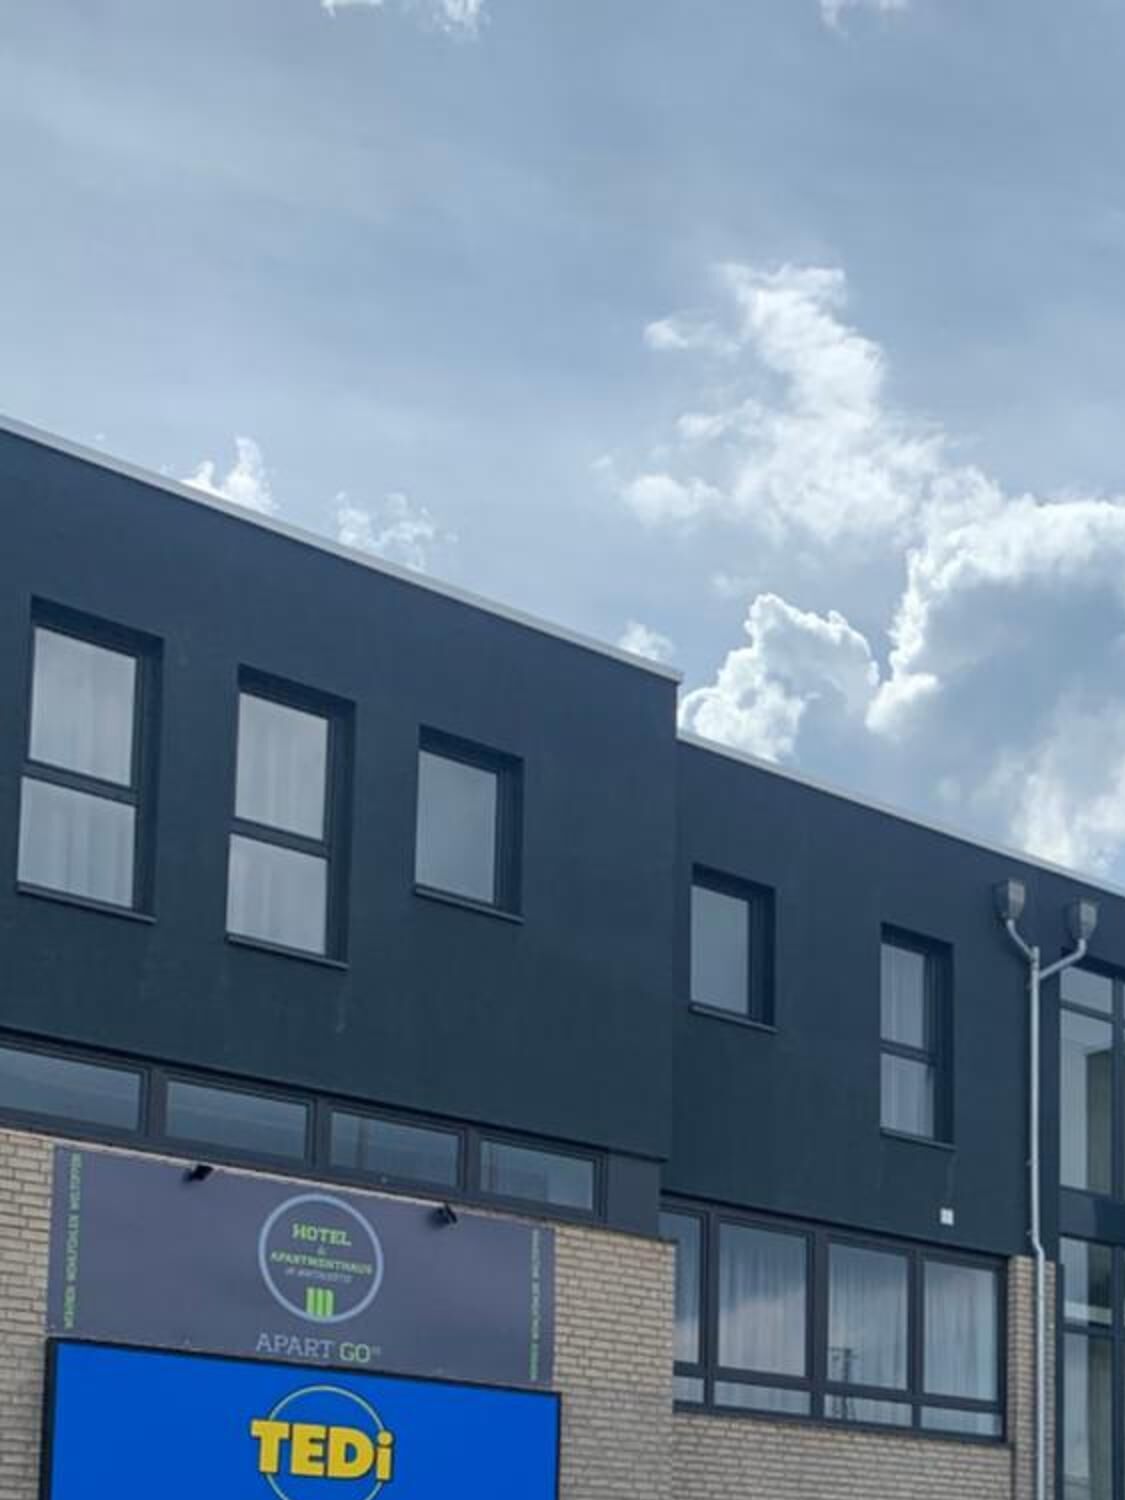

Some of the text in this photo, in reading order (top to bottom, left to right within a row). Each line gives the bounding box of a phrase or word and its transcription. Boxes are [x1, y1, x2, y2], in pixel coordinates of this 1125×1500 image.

[291, 1222, 353, 1247] HOTEL
[255, 1332, 334, 1360] APART
[250, 1419, 394, 1481] TEDi
